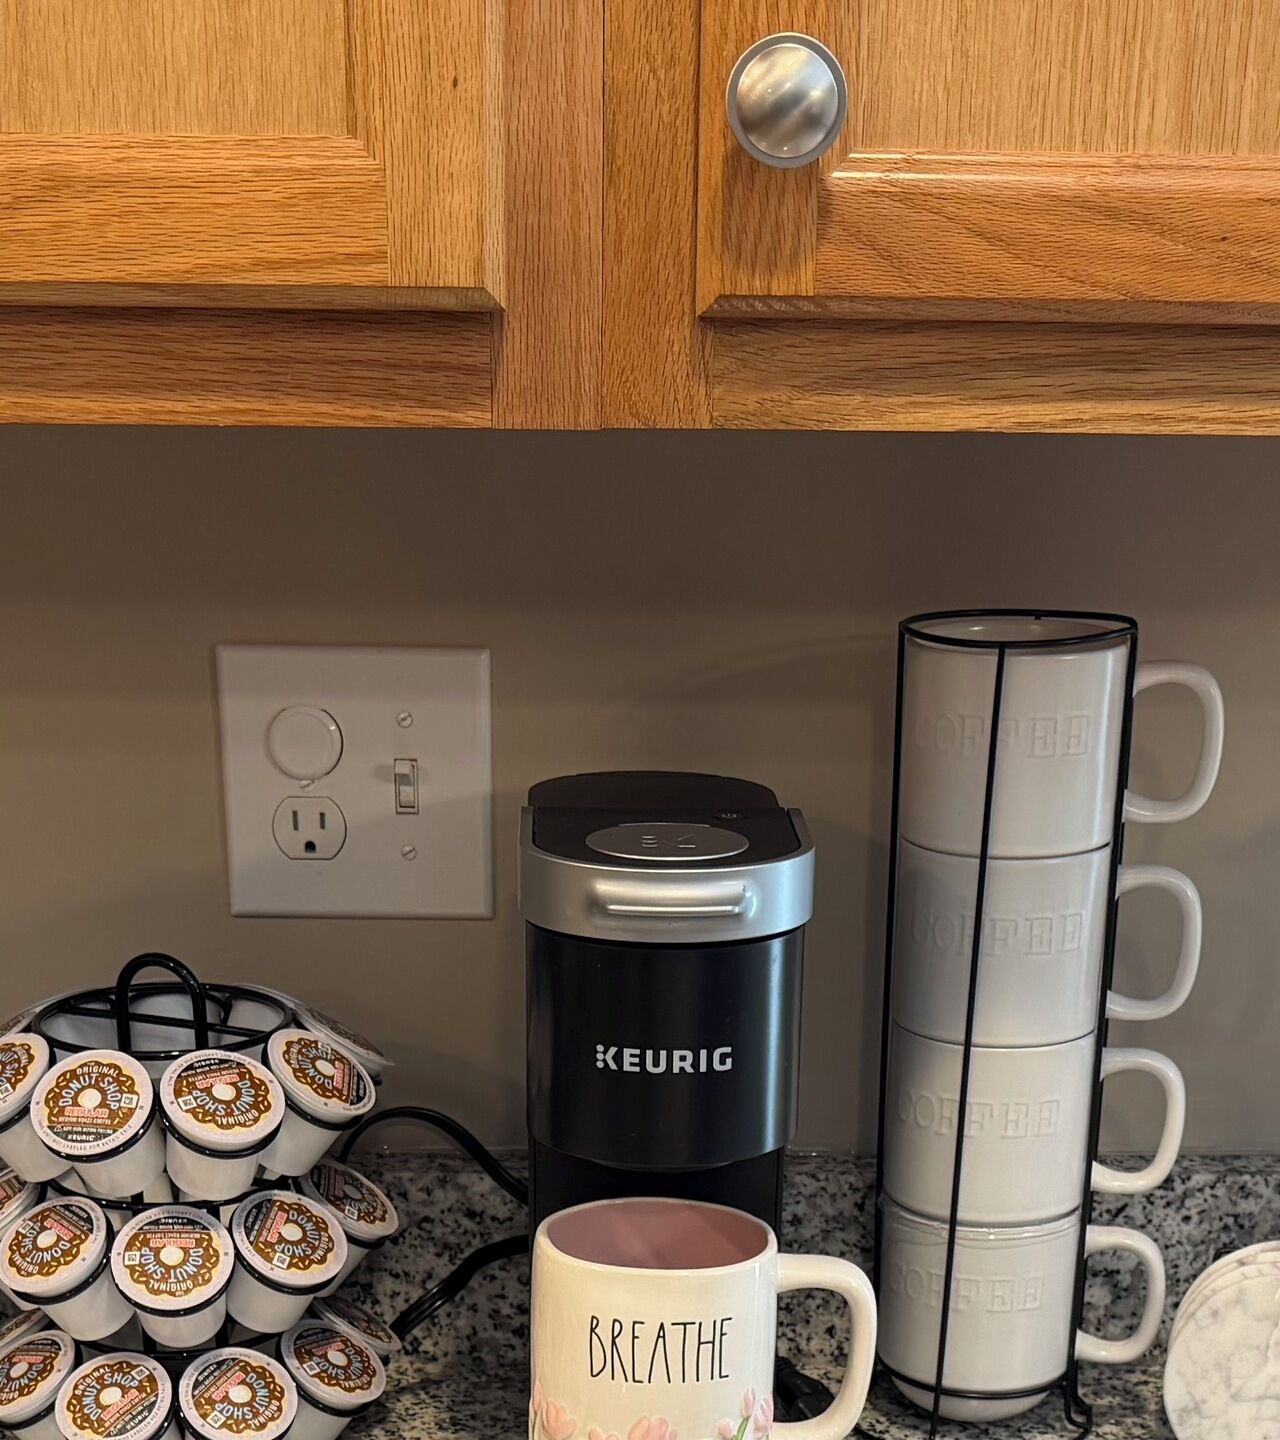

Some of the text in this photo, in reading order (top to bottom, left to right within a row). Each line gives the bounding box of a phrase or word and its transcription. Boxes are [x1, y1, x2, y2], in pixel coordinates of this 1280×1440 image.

[76, 1065, 119, 1077] ORIGINAL
[596, 1044, 733, 1074] KEURIG
[59, 1073, 122, 1110] DONUT SHOP
[192, 1080, 255, 1116] DONUT SHOP
[216, 1109, 259, 1125] ORIGINAL
[21, 1222, 71, 1264] DONUT SHOP
[275, 1210, 321, 1257] DONUT SHOP
[141, 1247, 204, 1282] DONUT SHOP
[149, 1279, 193, 1291] ORIGINAL
[589, 1315, 733, 1384] BREATHE
[4, 1363, 45, 1392] DONUT
[74, 1365, 111, 1396] ORIGINAL
[313, 1356, 345, 1380] SHOP
[82, 1372, 139, 1420] DONUT SHOP
[215, 1373, 270, 1420] DONUT SHOP
[248, 1400, 280, 1429] ORIGINAL
